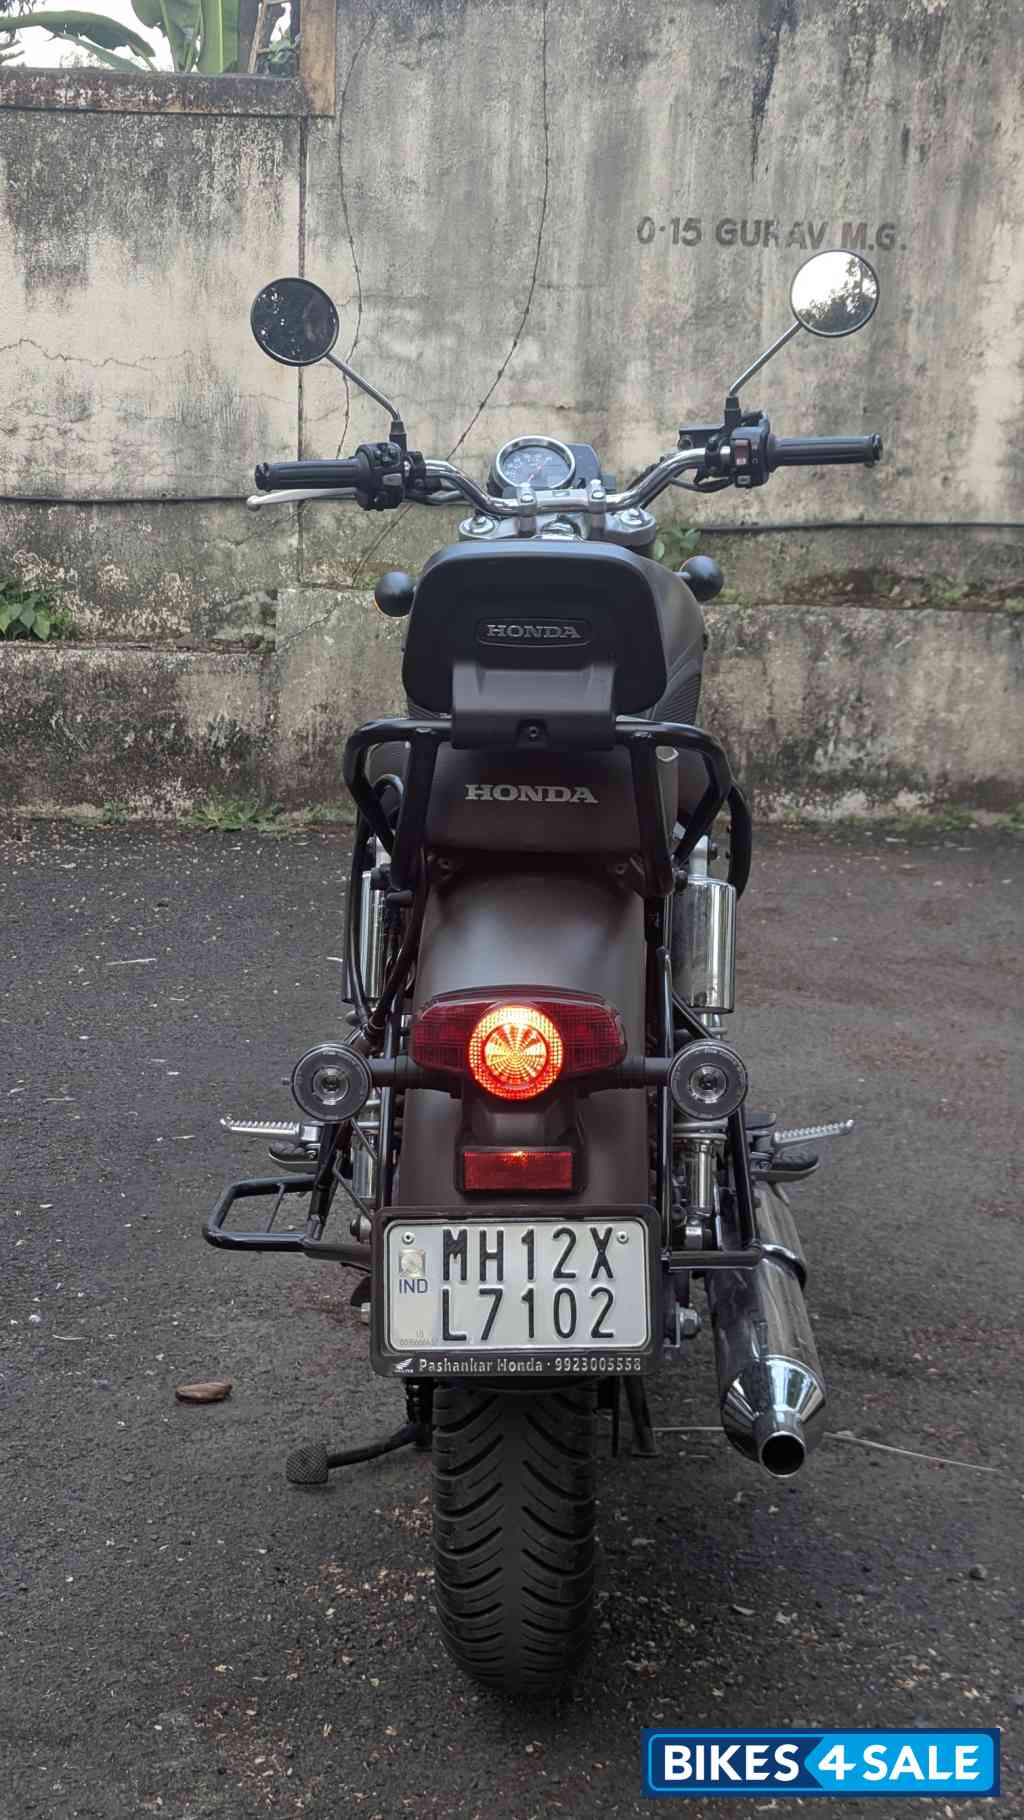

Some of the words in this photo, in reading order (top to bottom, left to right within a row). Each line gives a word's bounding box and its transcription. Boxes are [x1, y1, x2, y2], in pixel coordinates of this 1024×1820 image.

[487, 625, 581, 638] HONDA
[464, 784, 599, 804] HONDA
[399, 1279, 428, 1293] IND
[442, 1287, 614, 1341] L7102
[418, 1357, 493, 1373] Pashankar
[497, 1357, 543, 1373] Honda
[555, 1357, 641, 1372] 9923005558
